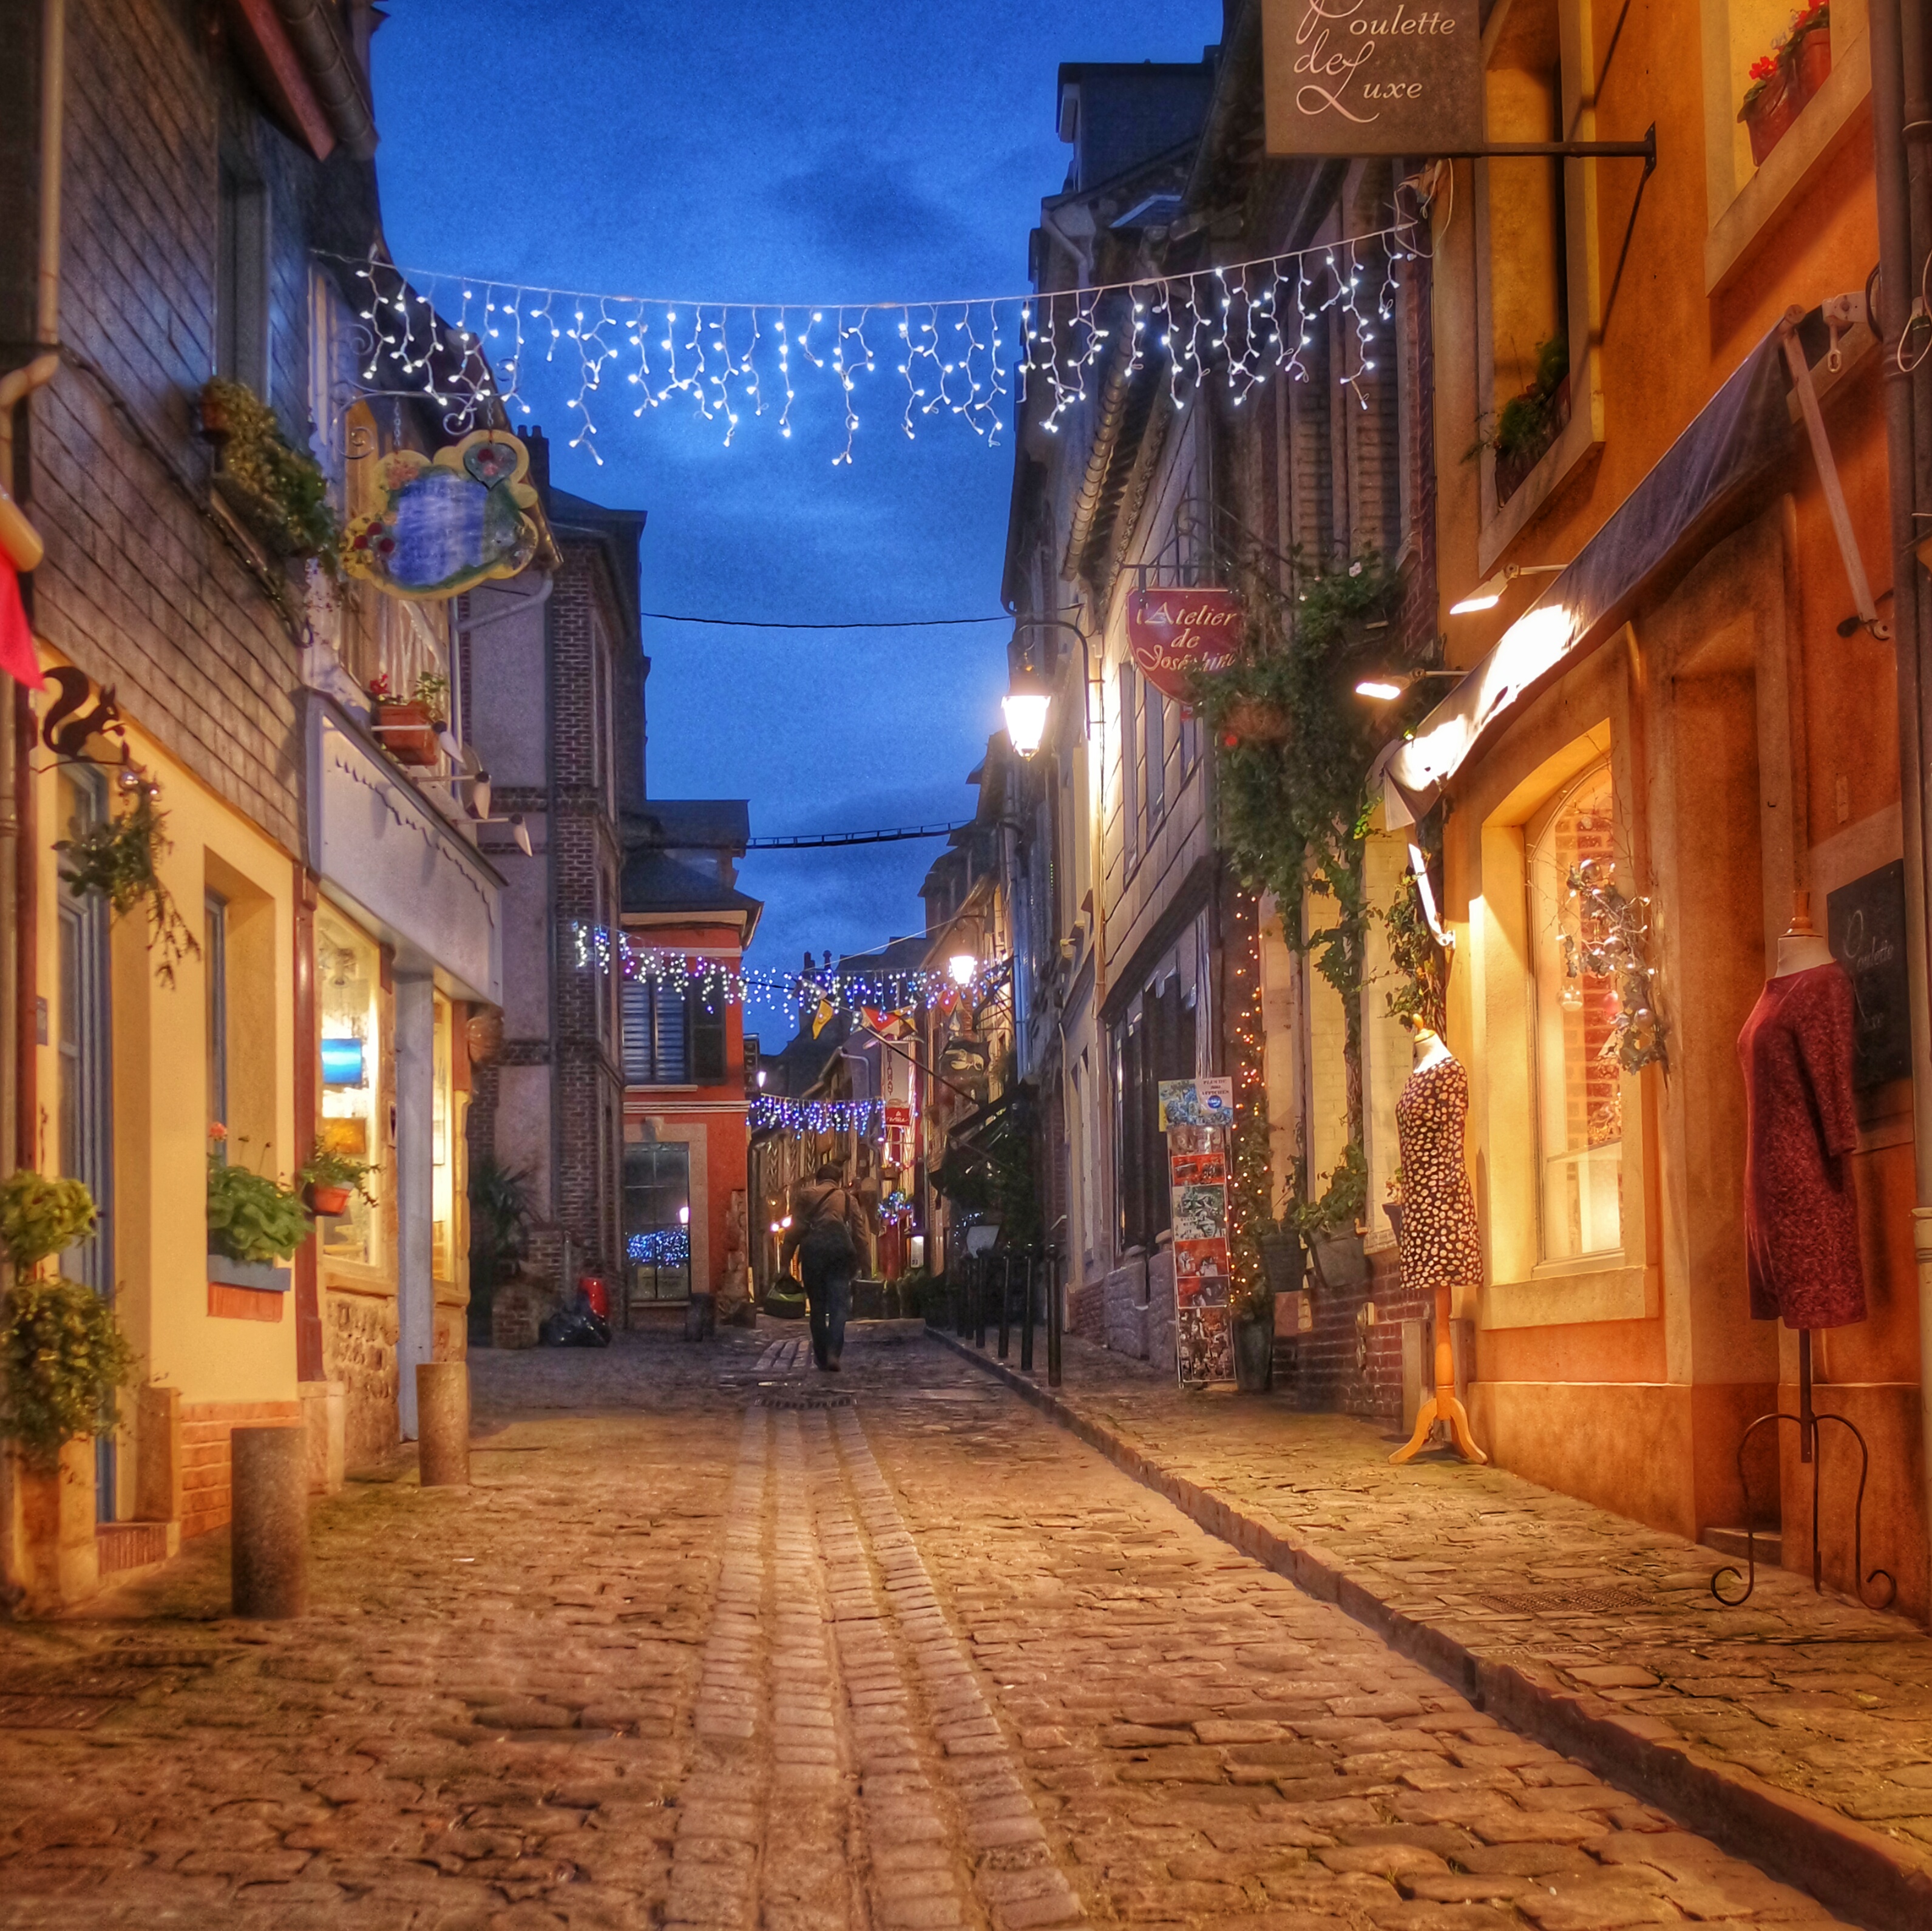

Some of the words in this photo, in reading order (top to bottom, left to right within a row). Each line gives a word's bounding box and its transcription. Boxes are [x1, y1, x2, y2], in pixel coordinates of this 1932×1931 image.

[1293, 29, 1349, 75] de
[1296, 40, 1423, 123] Luxe
[1170, 627, 1201, 649] de
[1136, 644, 1236, 672] Joséhine
